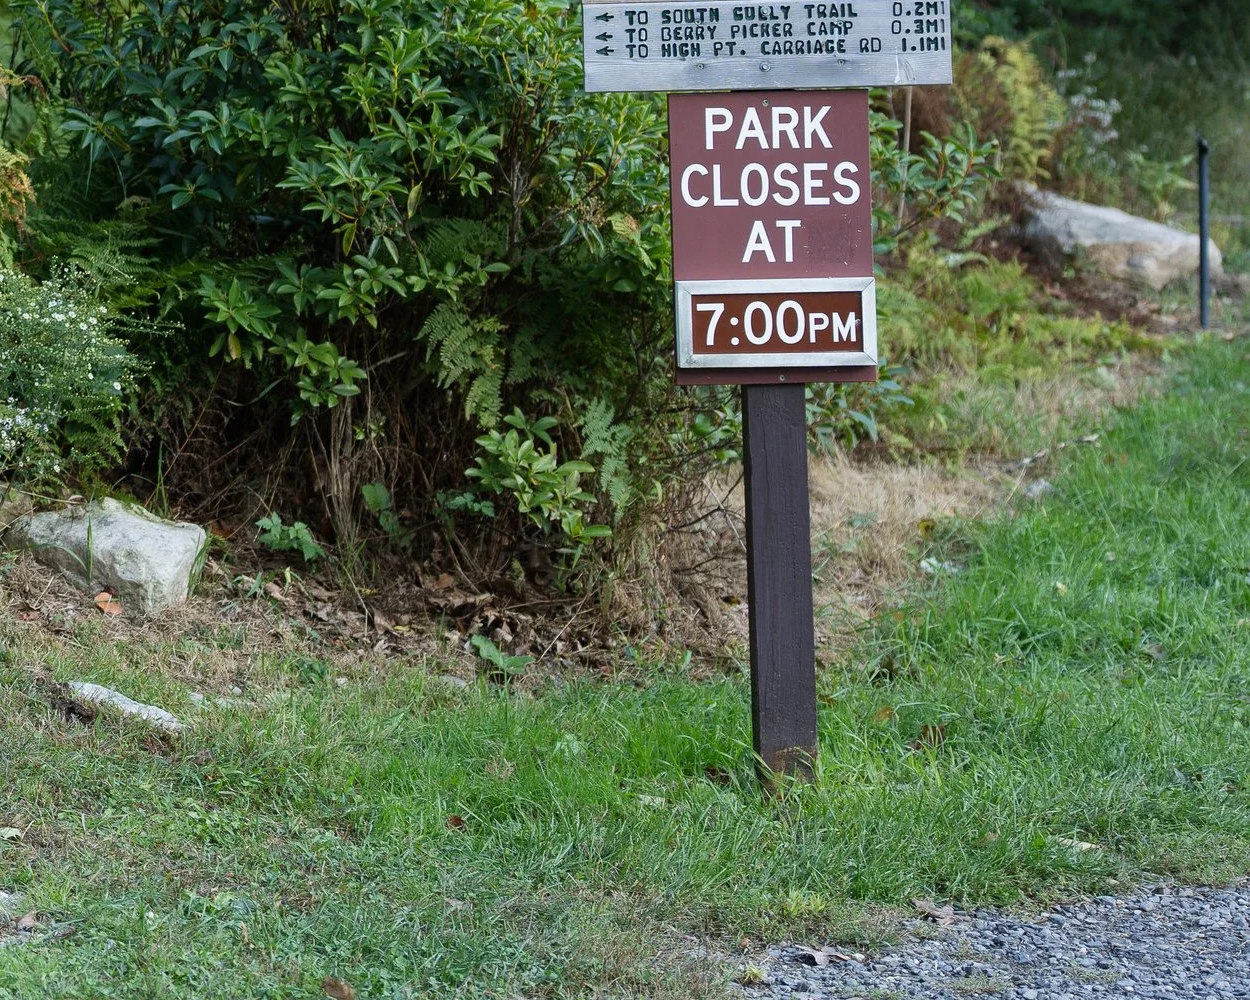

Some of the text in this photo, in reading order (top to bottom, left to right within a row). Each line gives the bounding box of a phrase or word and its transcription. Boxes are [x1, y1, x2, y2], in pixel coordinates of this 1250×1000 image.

[625, 11, 648, 25] TO
[662, 8, 719, 24] SOUTH
[804, 3, 857, 18] TRAIL
[625, 21, 853, 43] TO BERRY PICKER CAMP
[626, 38, 881, 58] TO HIGH PT. CARRIAGE RD
[705, 106, 832, 150] PARK
[681, 162, 860, 207] CLOSES
[742, 220, 801, 262] AT
